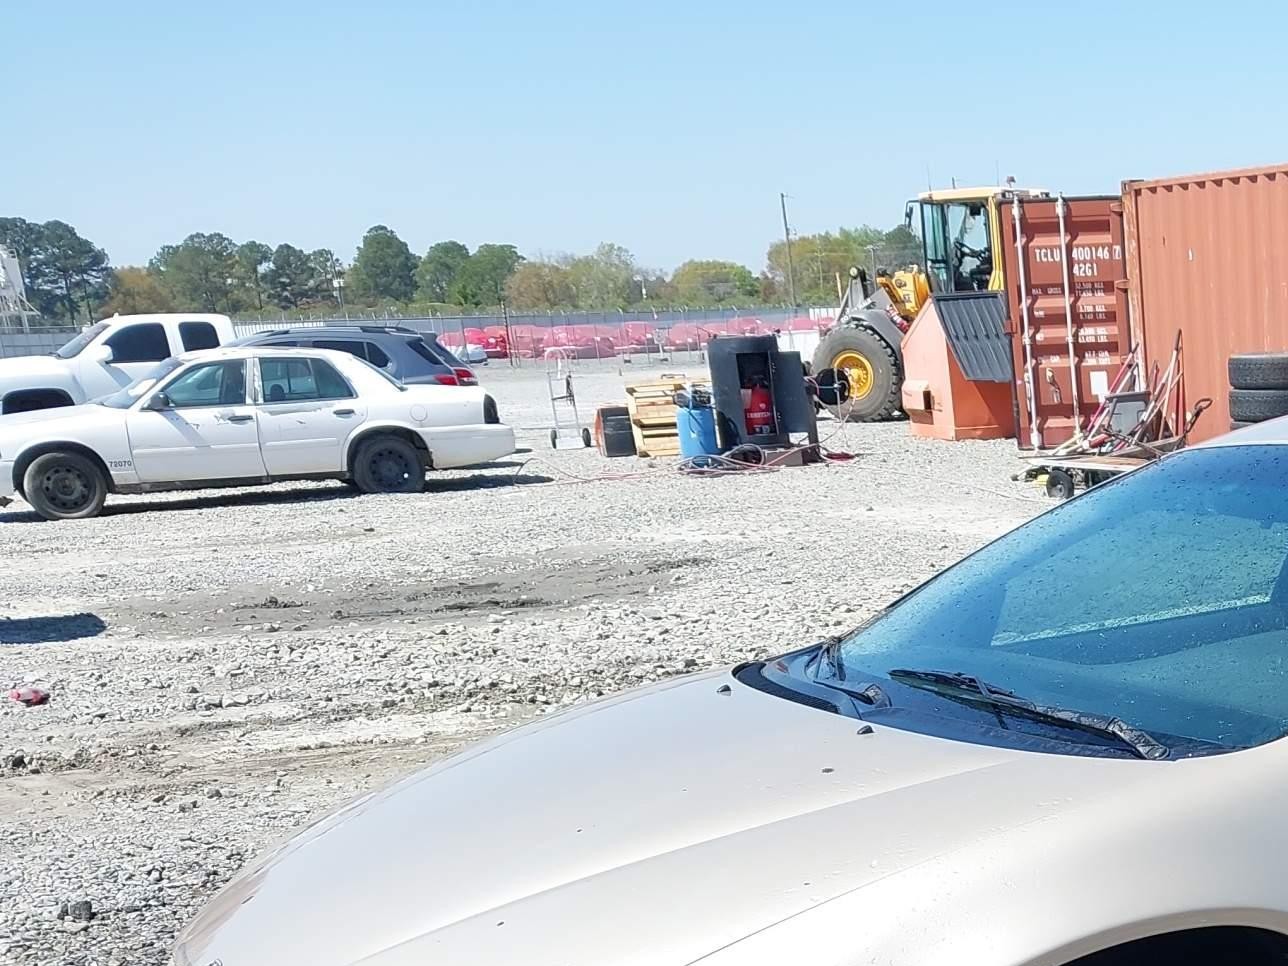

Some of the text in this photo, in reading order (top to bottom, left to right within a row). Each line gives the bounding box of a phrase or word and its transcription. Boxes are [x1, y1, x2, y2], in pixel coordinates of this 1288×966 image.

[1034, 248, 1060, 262] TCLU
[1072, 246, 1109, 261] 400146
[1073, 263, 1097, 276] 42G1
